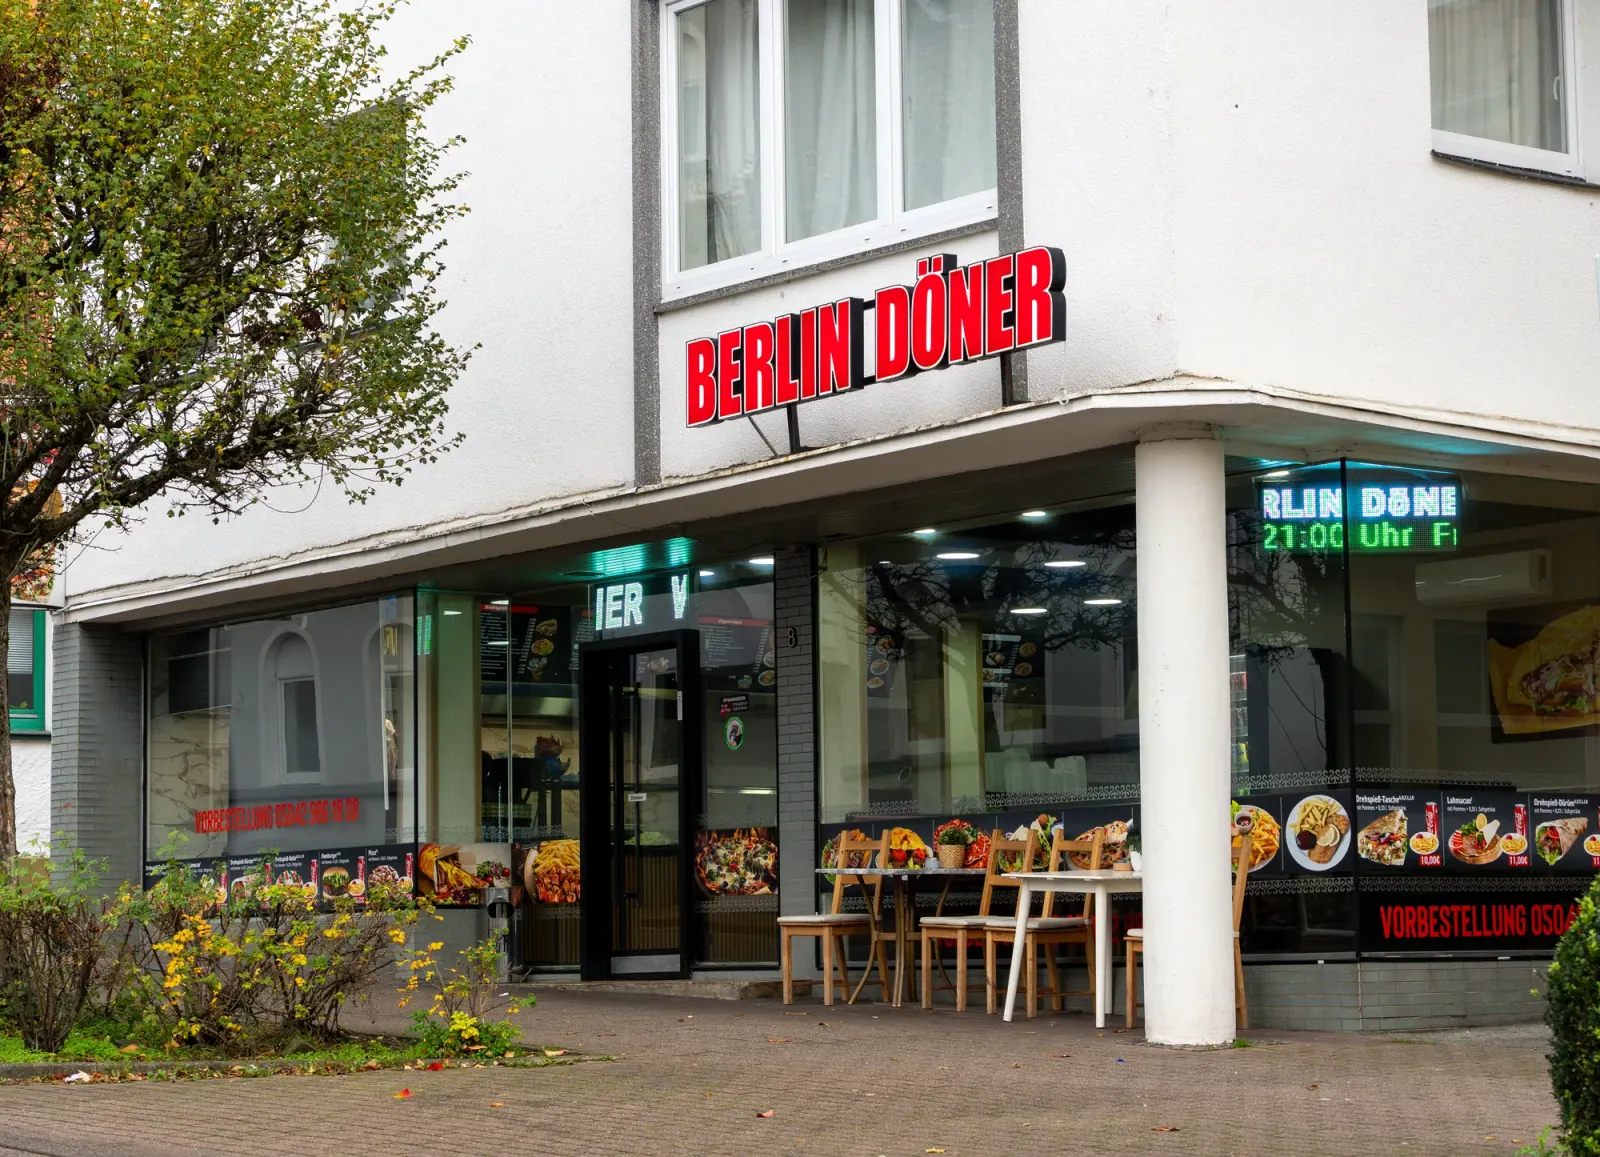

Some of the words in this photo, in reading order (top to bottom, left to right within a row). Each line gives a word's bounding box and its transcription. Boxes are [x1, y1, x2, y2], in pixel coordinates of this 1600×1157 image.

[686, 298, 851, 427] BERLIN
[875, 246, 1053, 381] DÖNER
[1264, 523, 1343, 548] 21:00
[1360, 522, 1412, 547] Uhr
[788, 628, 797, 648] 8
[194, 805, 273, 834] VORBESTELLUNG
[1421, 856, 1440, 865] 10,00€
[1509, 856, 1528, 865] 11,00€
[1380, 904, 1526, 938] VORBESTELLUNG
